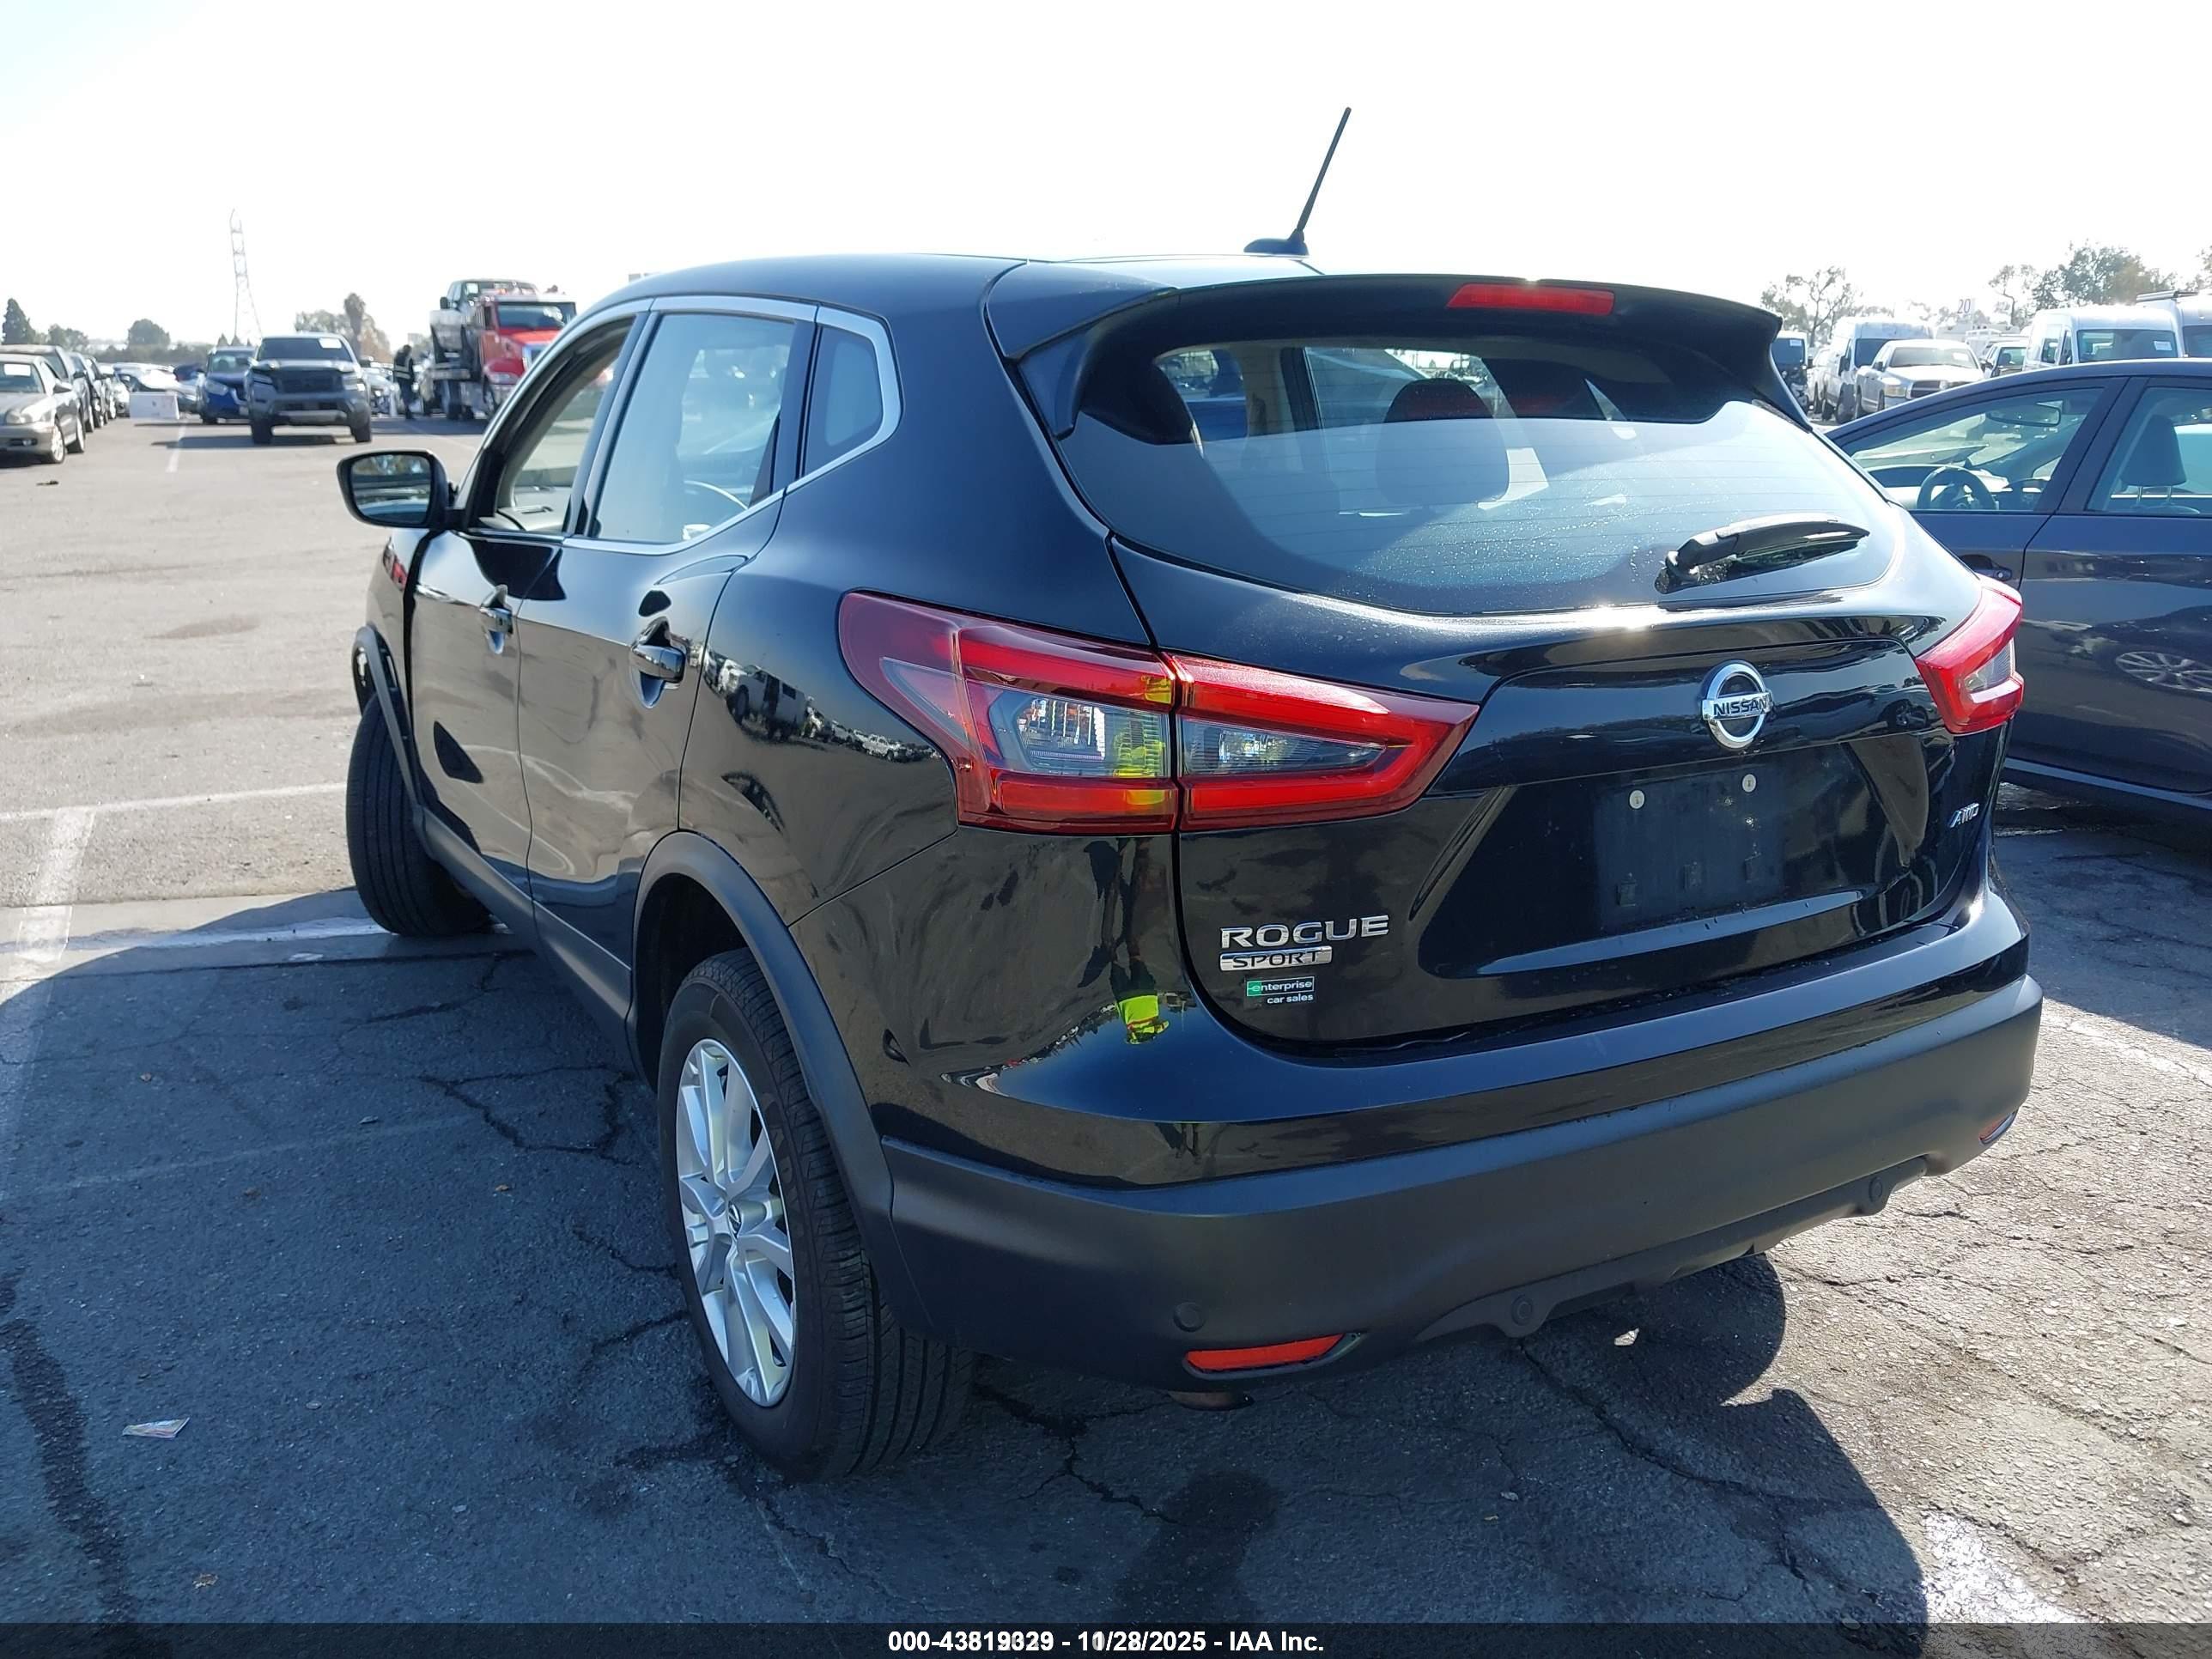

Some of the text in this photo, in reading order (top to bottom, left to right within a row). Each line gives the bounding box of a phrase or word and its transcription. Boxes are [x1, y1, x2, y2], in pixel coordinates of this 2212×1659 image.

[1957, 298, 1971, 314] 20
[1713, 696, 1767, 715] NISSAN
[1949, 803, 1979, 828] AWD
[1220, 915, 1389, 949] ROGUE
[1232, 949, 1321, 969] SPORT
[1249, 981, 1313, 993] enterprise
[1267, 993, 1314, 1004] car sales
